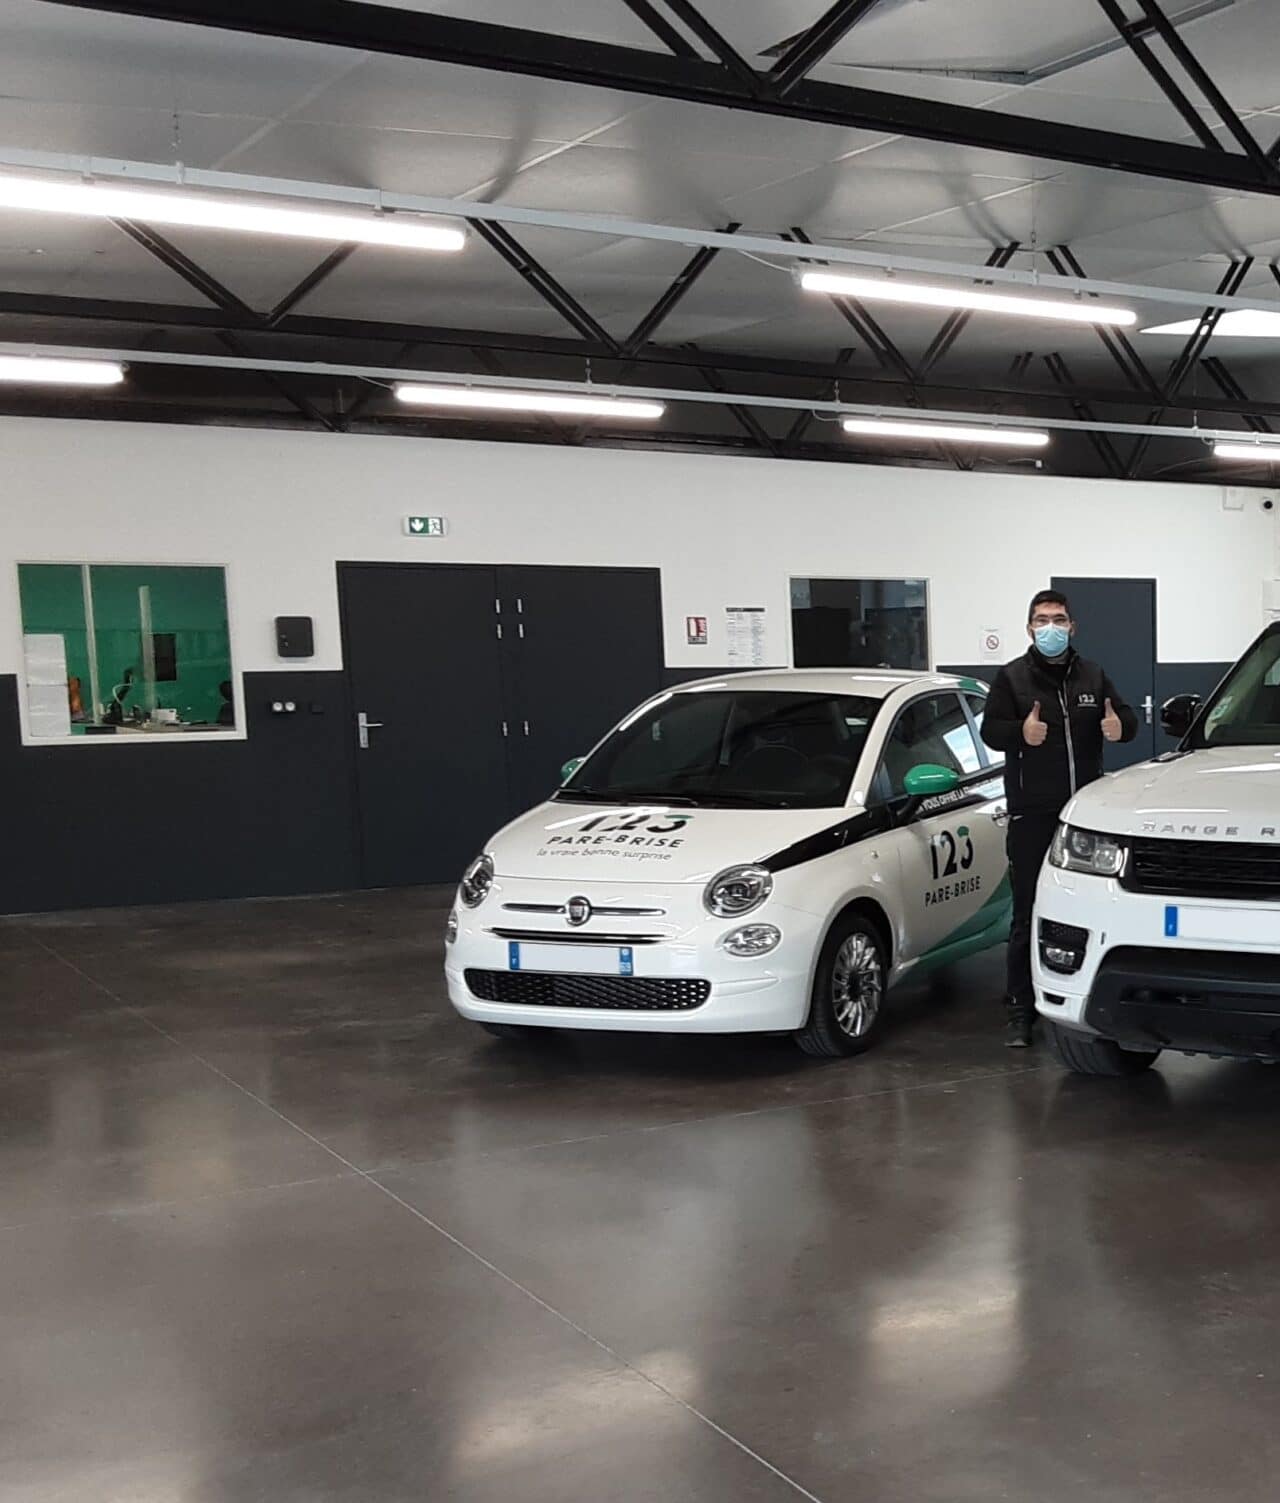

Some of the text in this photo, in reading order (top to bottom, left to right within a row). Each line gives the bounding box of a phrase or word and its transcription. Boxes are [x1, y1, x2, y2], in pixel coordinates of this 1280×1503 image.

[1078, 694, 1095, 703] 123
[578, 813, 695, 833] 123
[546, 834, 685, 848] PARE-BRISE
[550, 849, 579, 857] vraie
[581, 848, 620, 857] bonne
[622, 851, 673, 862] surprise
[930, 826, 974, 880] 123
[925, 875, 981, 907] PARE-BRISE
